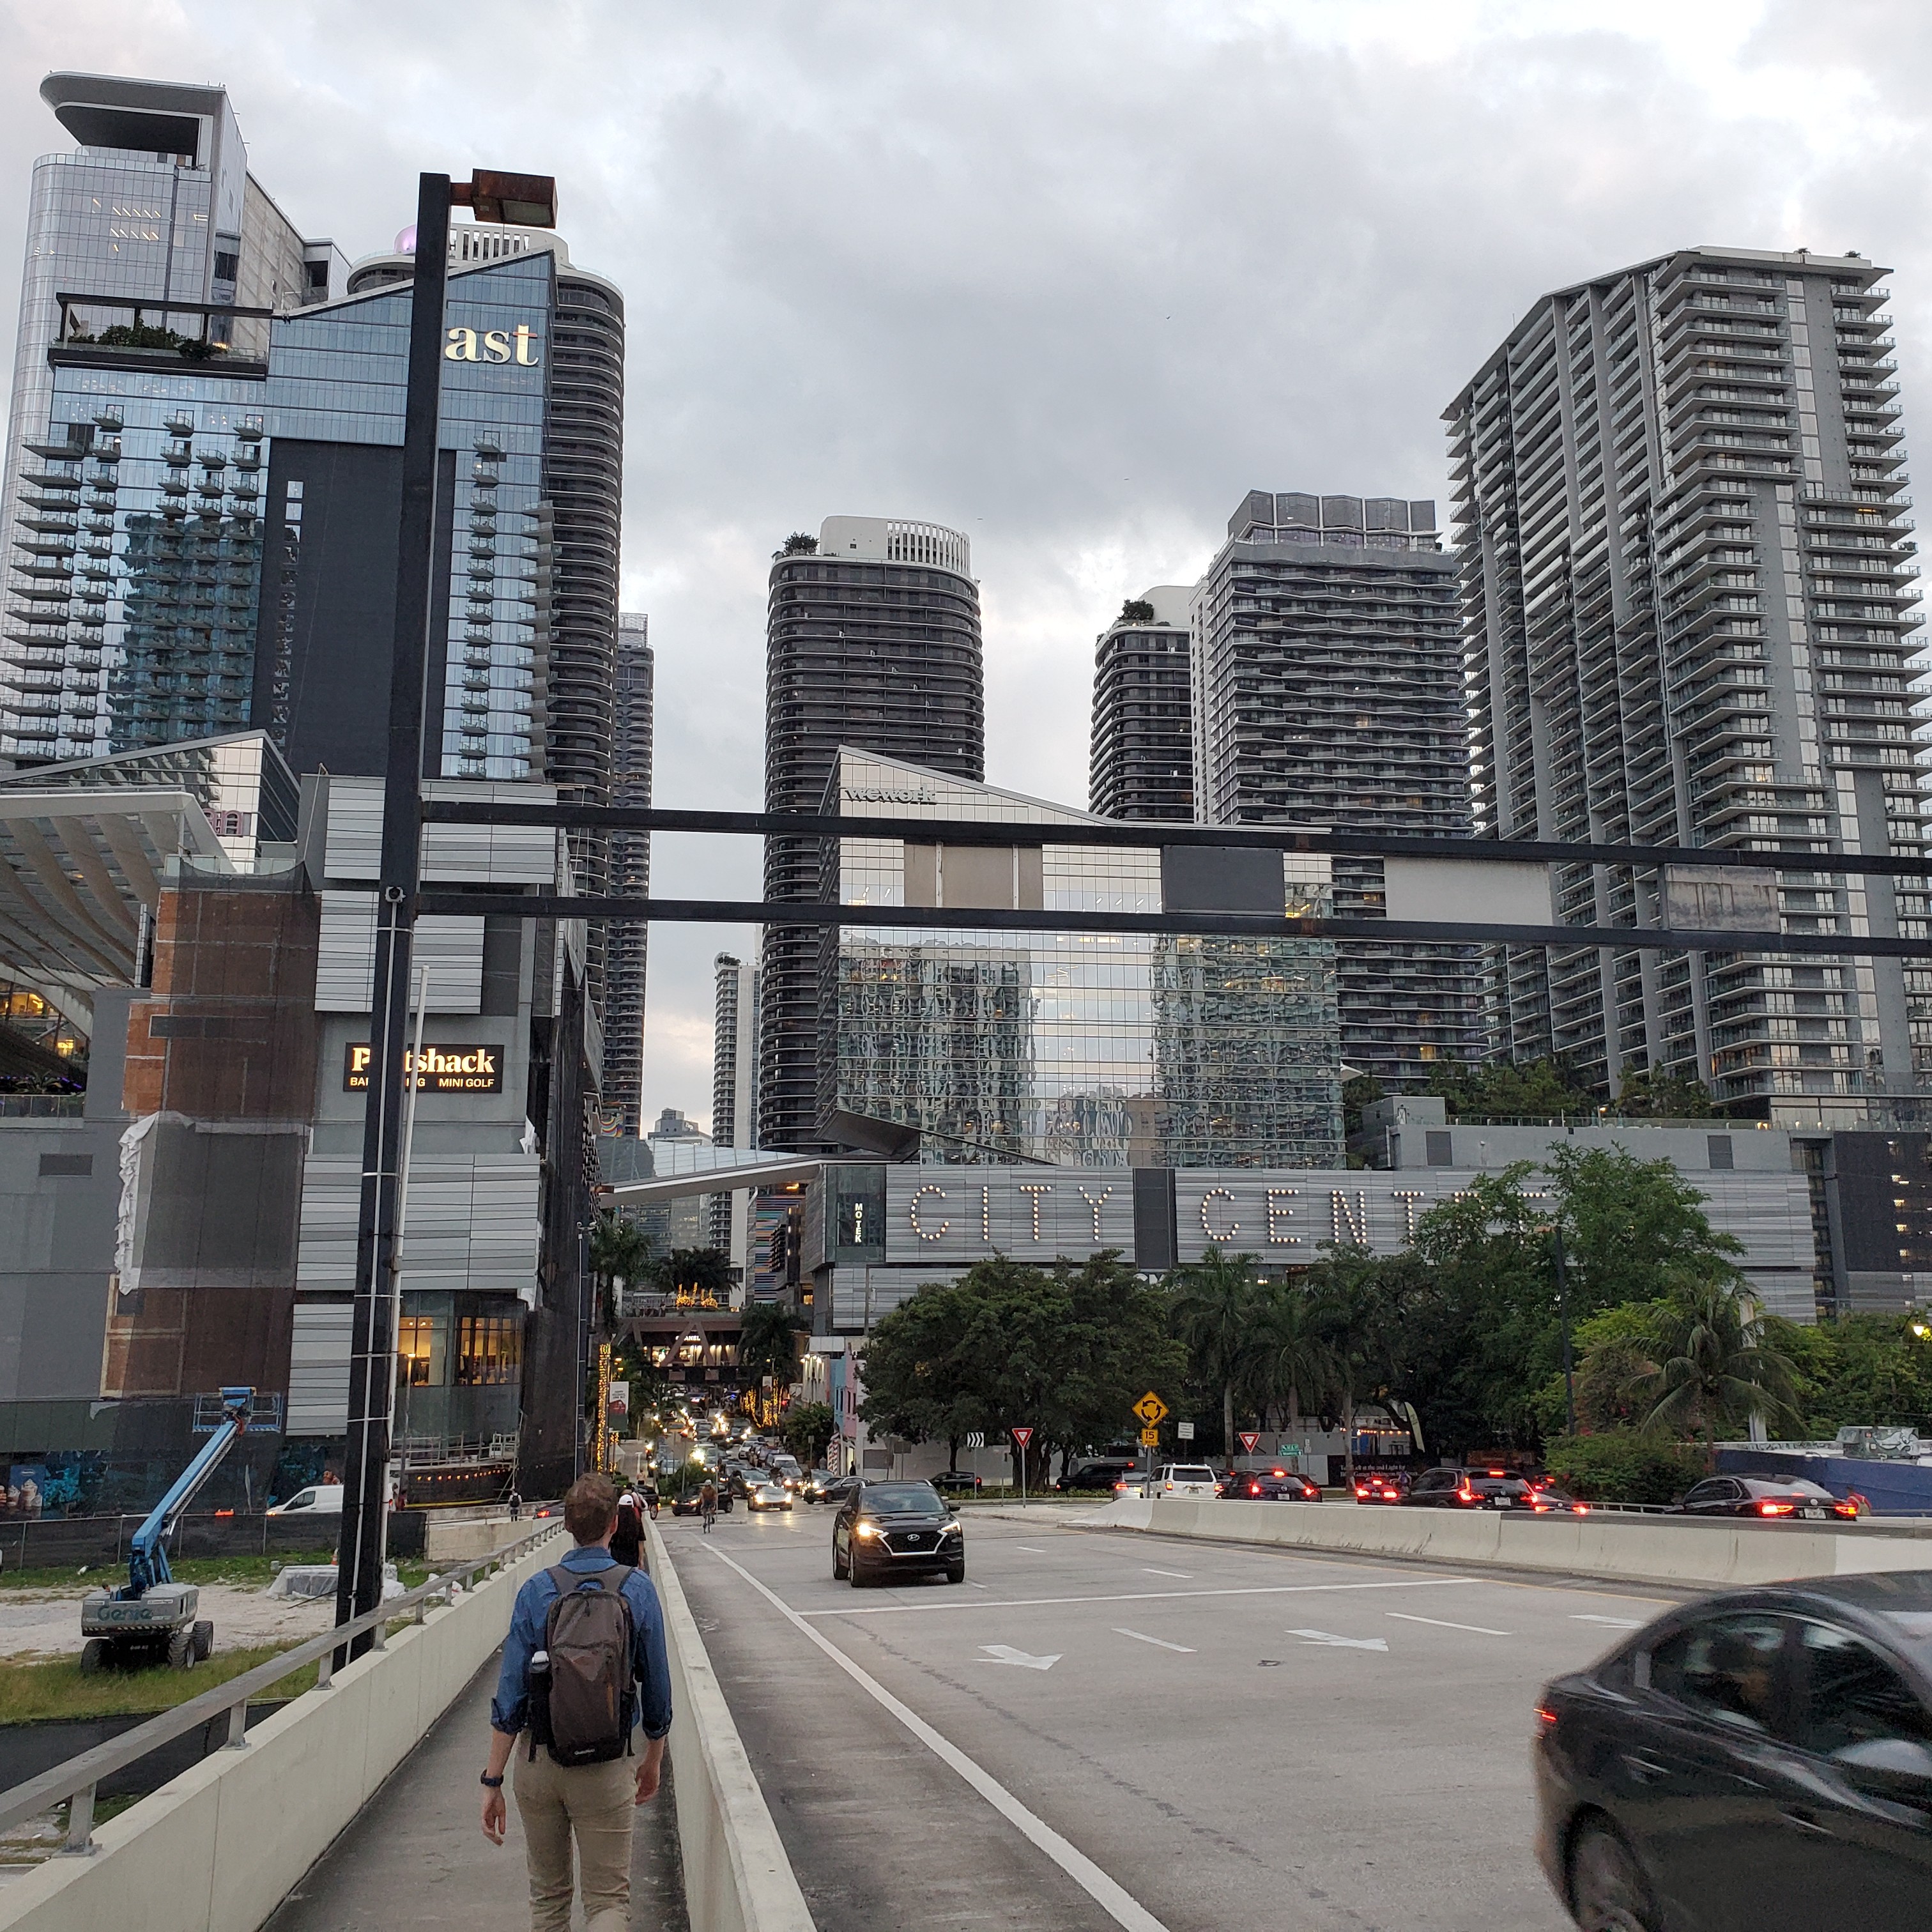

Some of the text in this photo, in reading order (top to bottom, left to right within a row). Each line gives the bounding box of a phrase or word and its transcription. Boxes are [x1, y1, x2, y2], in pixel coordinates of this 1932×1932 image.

[445, 325, 539, 366] ast
[846, 783, 937, 803] wework
[351, 1047, 495, 1073] Ptshack
[351, 1077, 495, 1087] BA MINI GOLF
[855, 1203, 863, 1243] MOTEK
[910, 1184, 1113, 1241] CITY
[1145, 1431, 1154, 1439] 15
